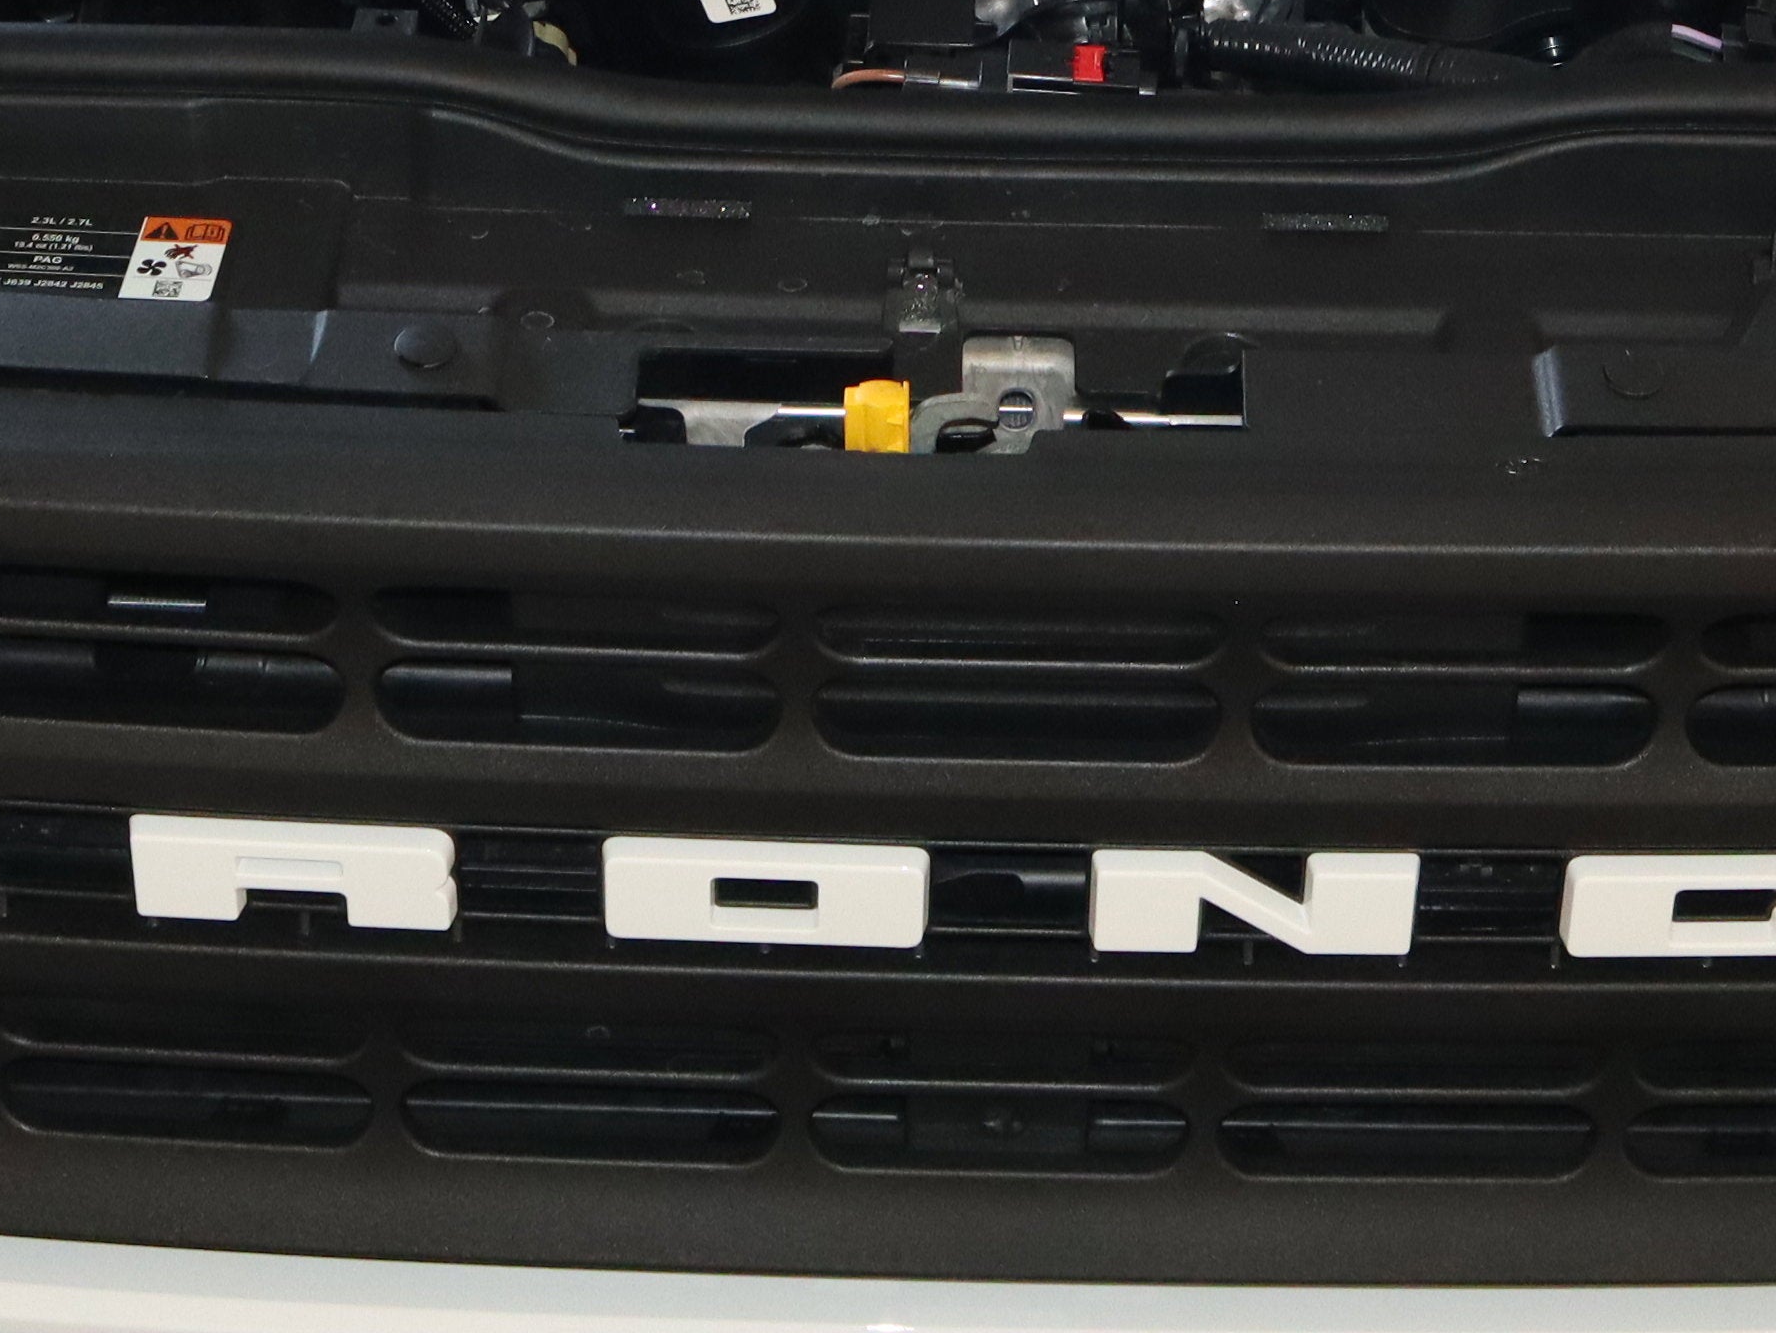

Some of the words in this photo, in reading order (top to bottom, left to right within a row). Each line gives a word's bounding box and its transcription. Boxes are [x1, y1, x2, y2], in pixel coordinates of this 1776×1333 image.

[30, 216, 57, 225] 2.3L
[67, 218, 93, 227] 2.7L
[32, 255, 62, 264] PAG
